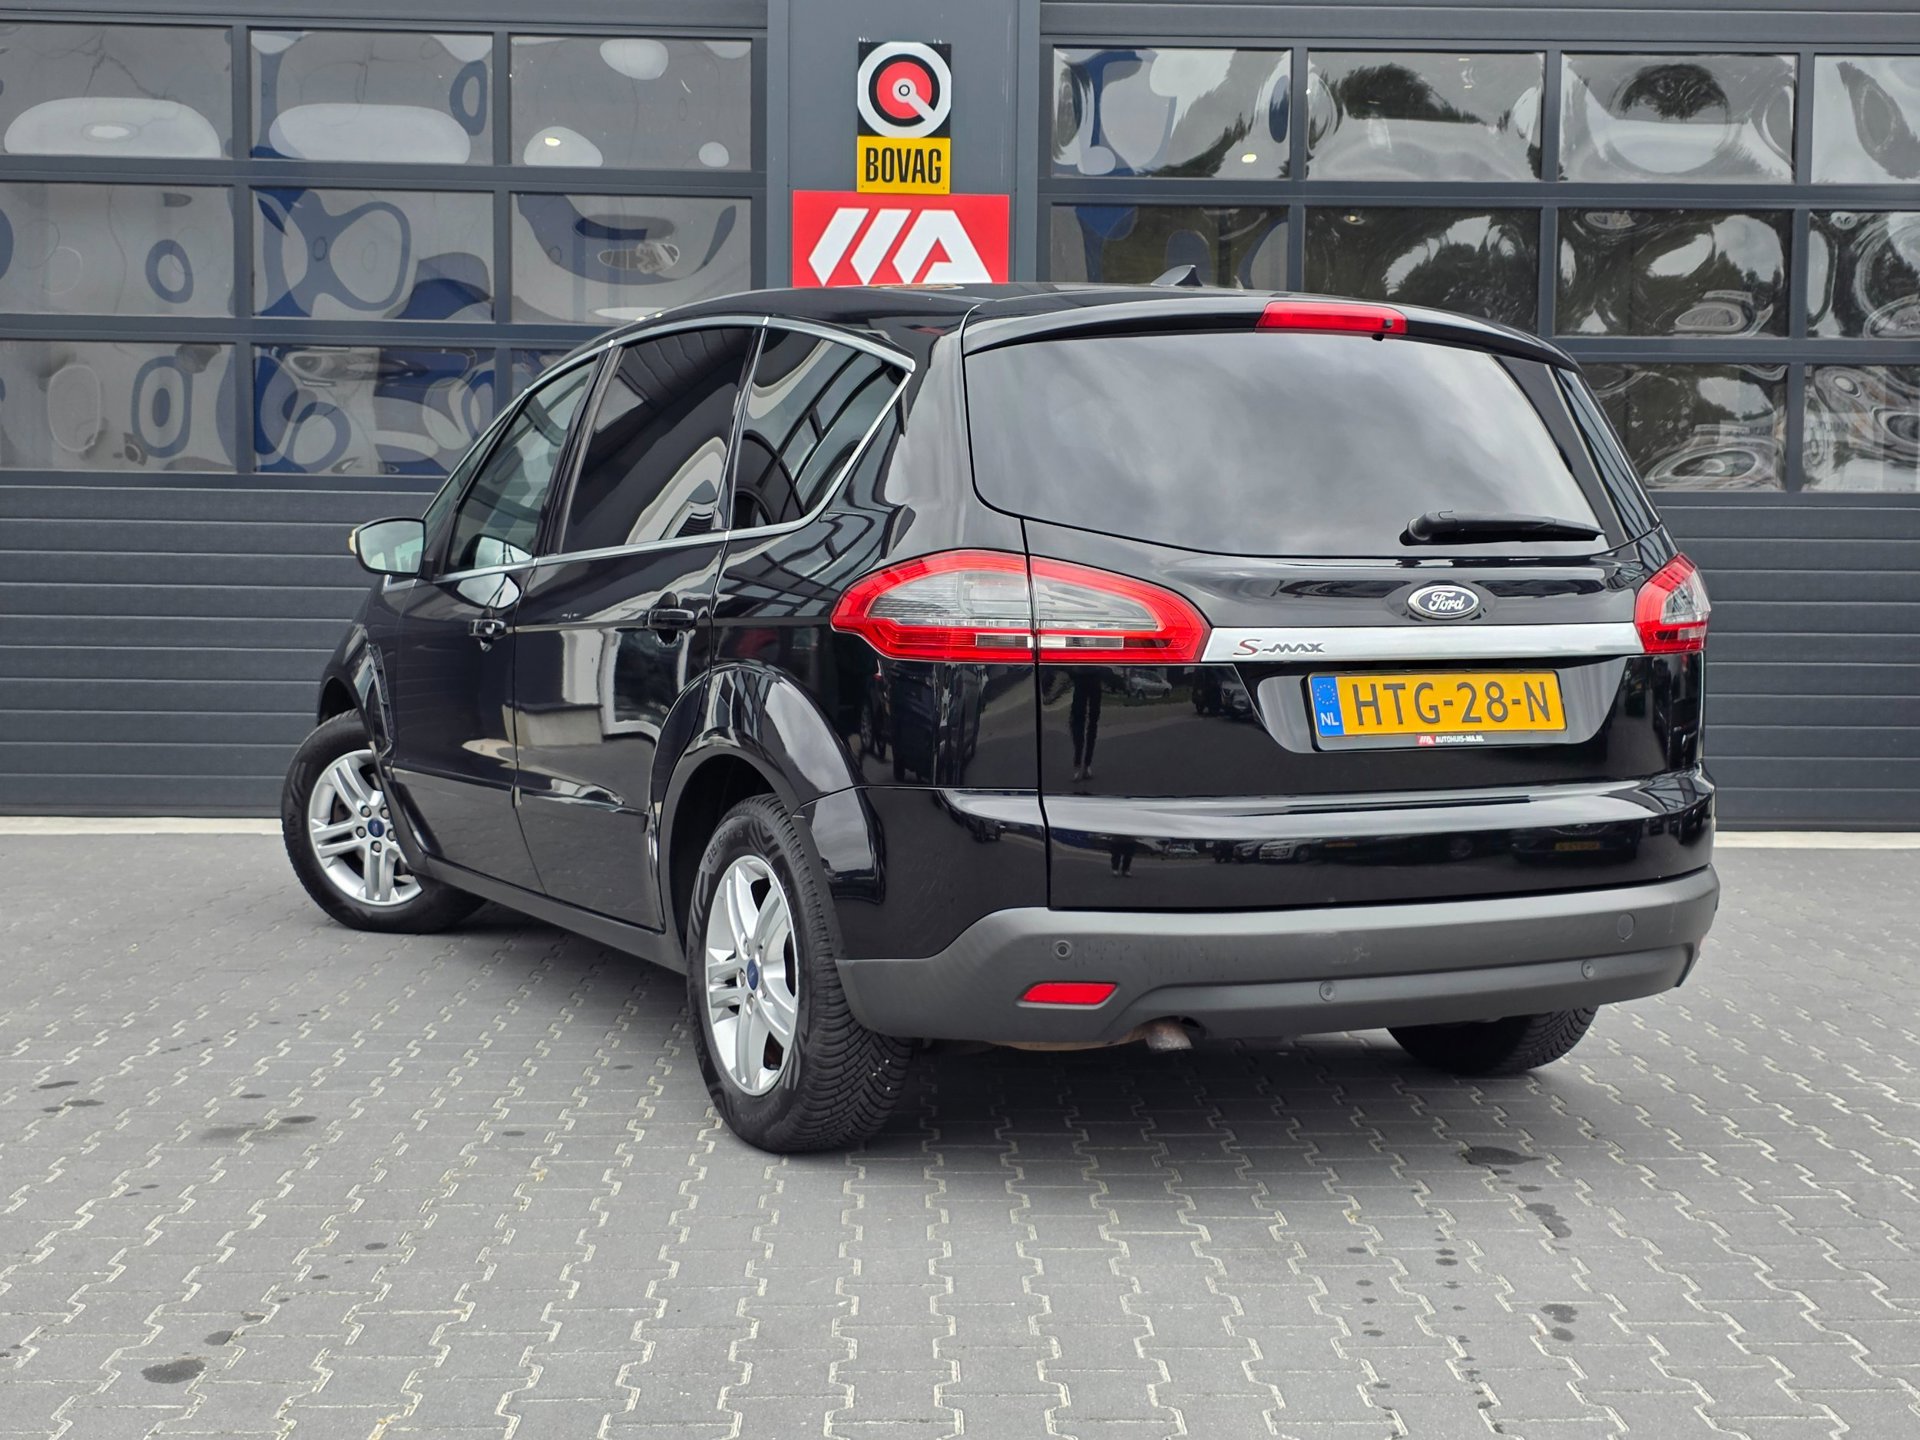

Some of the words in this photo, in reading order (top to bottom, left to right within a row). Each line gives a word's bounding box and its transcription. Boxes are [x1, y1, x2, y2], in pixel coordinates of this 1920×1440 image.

[865, 147, 942, 184] BOVAG
[1428, 591, 1465, 611] Ford
[1232, 638, 1326, 656] S-MAX
[1352, 681, 1550, 726] HTG-28-N
[1320, 712, 1340, 726] NL
